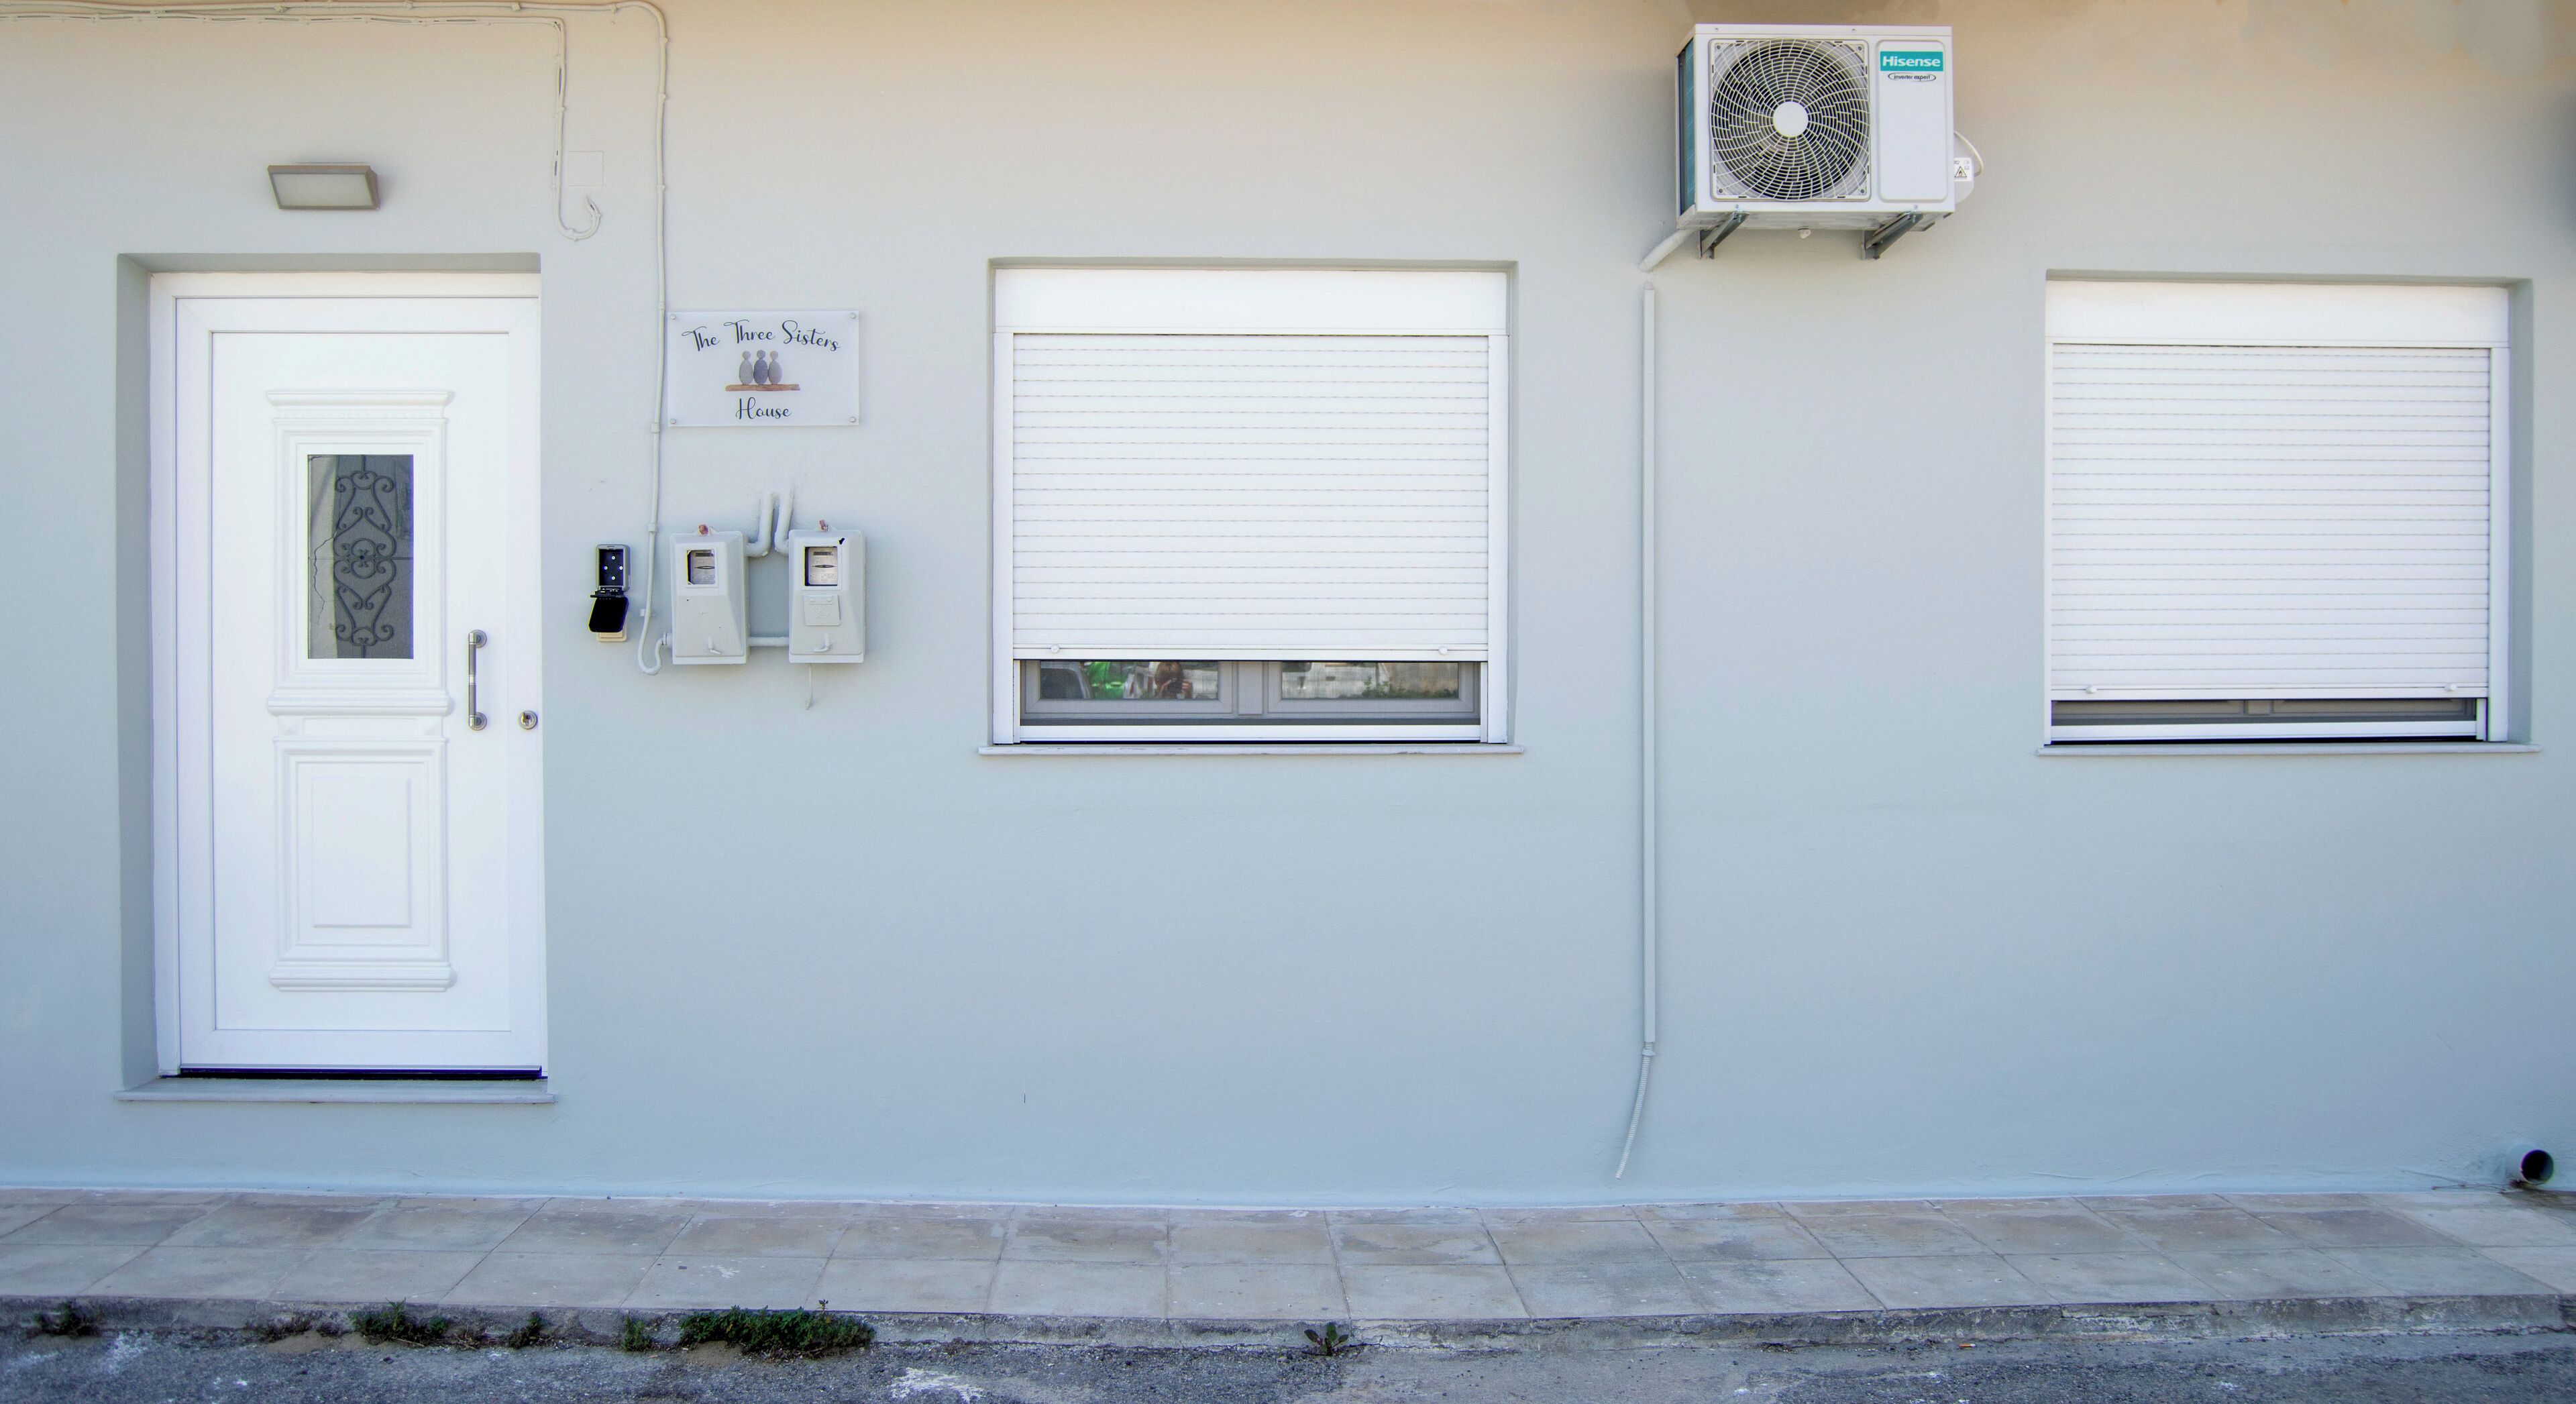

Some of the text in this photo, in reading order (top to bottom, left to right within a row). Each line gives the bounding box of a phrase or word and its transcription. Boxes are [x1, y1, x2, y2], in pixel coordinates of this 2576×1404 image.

[1882, 56, 1941, 67] Hisense
[682, 319, 841, 352] The Three Sisters
[735, 396, 792, 419] House
